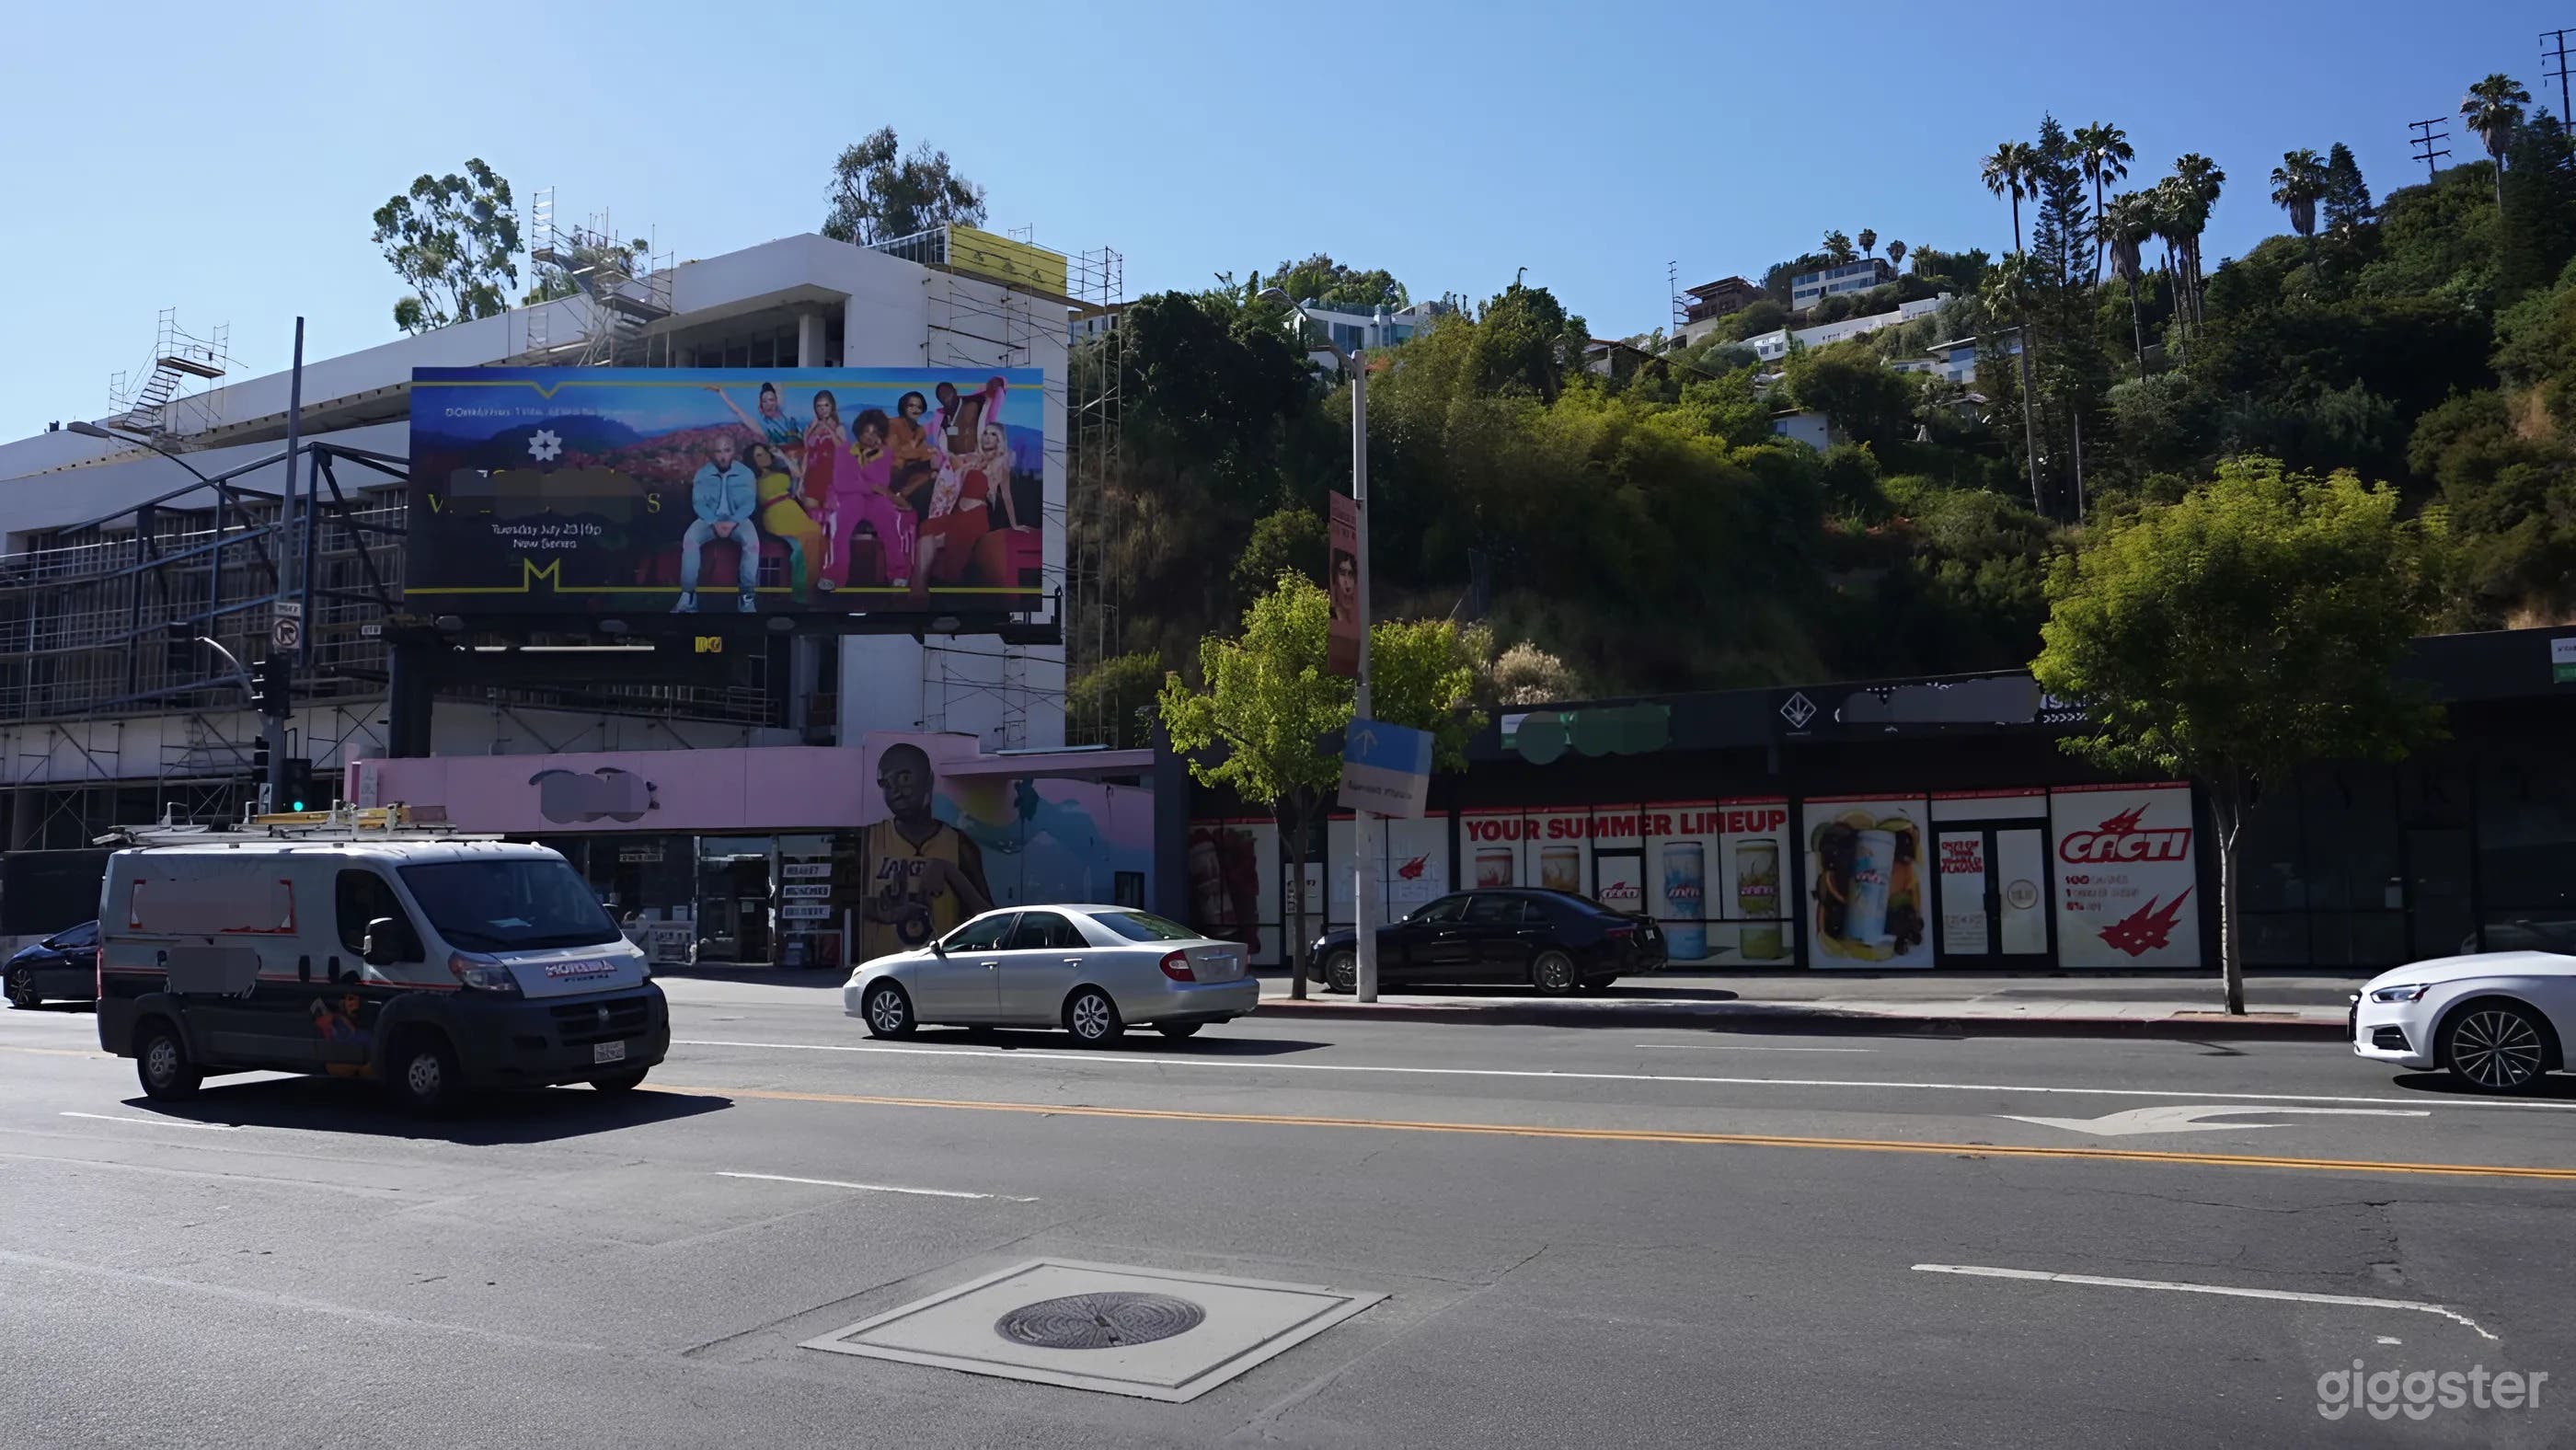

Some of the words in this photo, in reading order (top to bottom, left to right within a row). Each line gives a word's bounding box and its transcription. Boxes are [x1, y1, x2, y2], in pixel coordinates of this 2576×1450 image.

[1466, 820, 1540, 842] YOUR
[1547, 814, 1672, 839] SUMMER
[1681, 810, 1787, 835] LINEUP
[2061, 828, 2191, 864] CACTI
